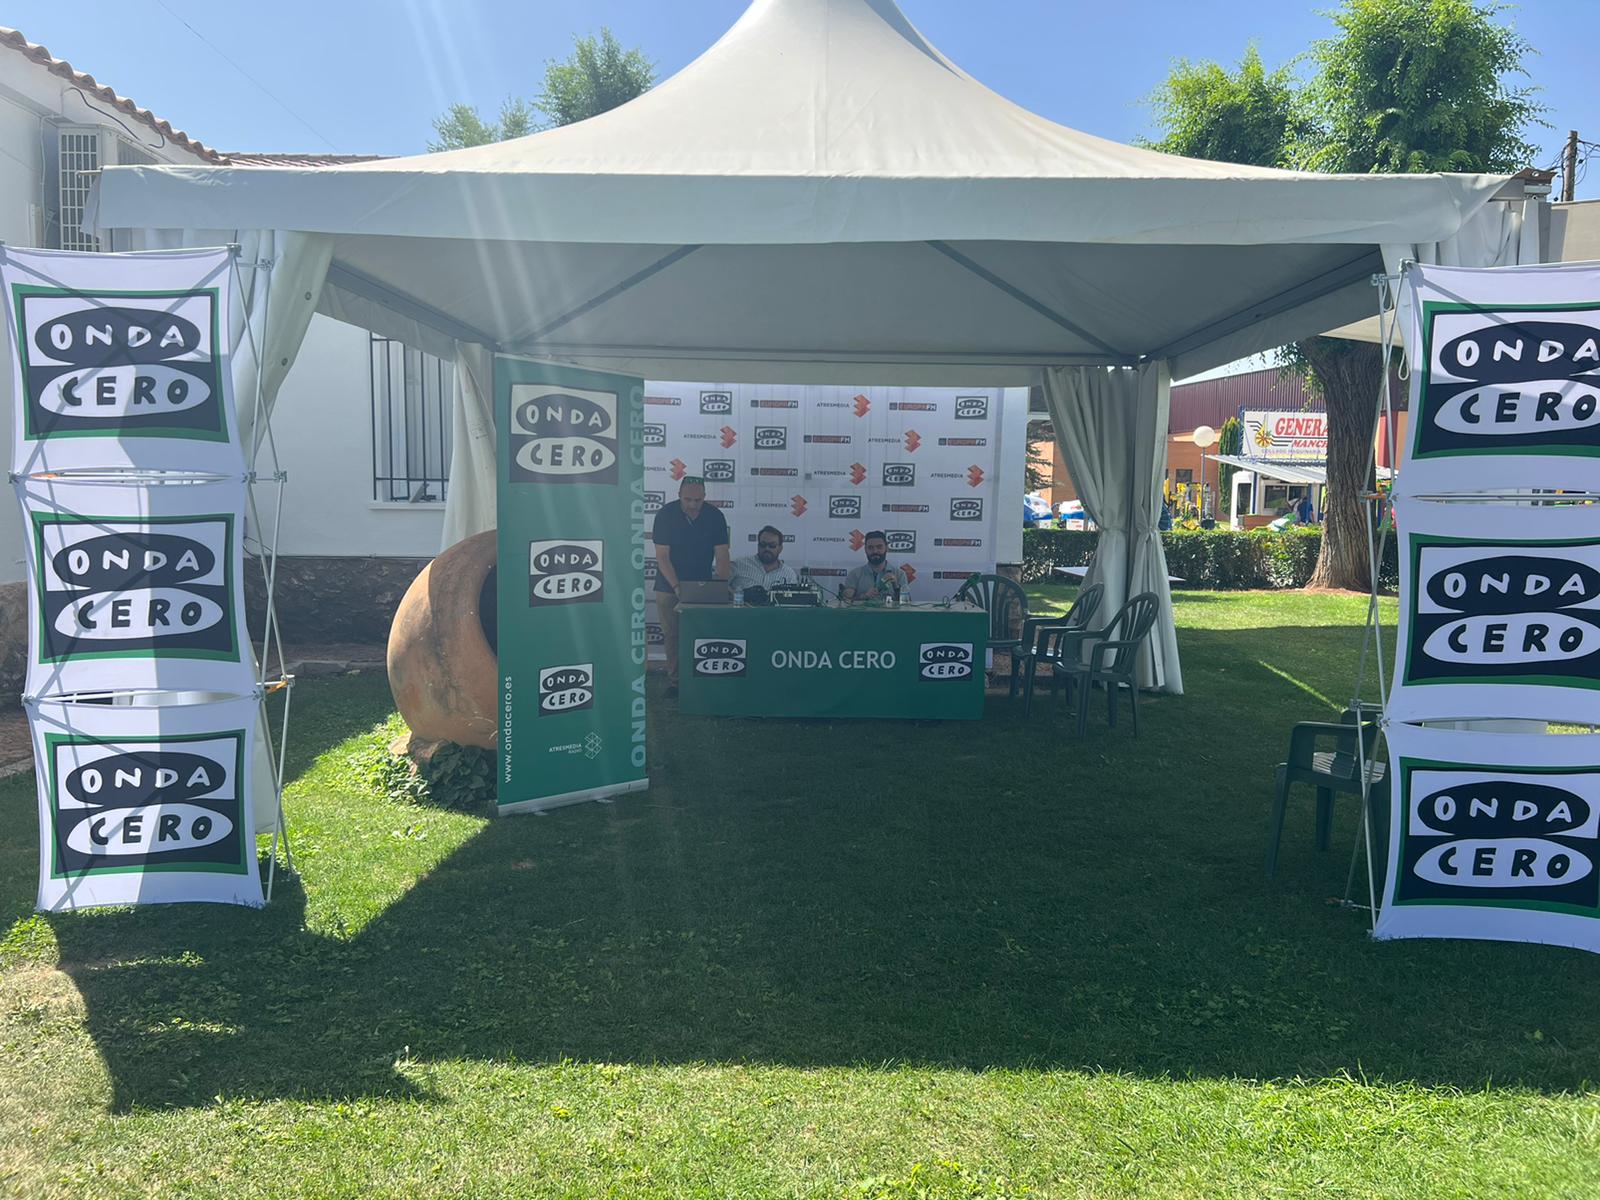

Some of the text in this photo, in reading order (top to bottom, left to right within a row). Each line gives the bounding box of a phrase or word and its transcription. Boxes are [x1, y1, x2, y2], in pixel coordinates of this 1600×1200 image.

[50, 324, 185, 350] ONDA
[1456, 338, 1600, 367] ONDA
[62, 376, 189, 406] CERO
[526, 405, 602, 428] ONDA
[1460, 392, 1597, 424] CERO
[530, 443, 603, 467] CERO
[68, 550, 200, 575] ONDA
[540, 554, 593, 567] ONDA
[543, 578, 593, 594] CERO
[630, 386, 646, 768] ONDA CERO ONDA CERO
[1444, 573, 1585, 598] ONDA
[78, 599, 202, 629] CERO
[701, 646, 739, 655] ONDA
[1448, 623, 1583, 653] CERO
[703, 661, 739, 671] CERO
[772, 650, 896, 669] ONDA CERO
[927, 650, 965, 659] ONDA
[547, 674, 585, 687] ONDA
[928, 665, 964, 675] CERO
[549, 692, 585, 706] CERO
[504, 676, 512, 784] www.ondacero.es
[549, 743, 582, 752] ATRESMEDIA
[81, 766, 211, 793] ONDA
[1434, 796, 1572, 823] ONDA
[90, 814, 212, 846] CERO
[1438, 847, 1570, 879] CERO
